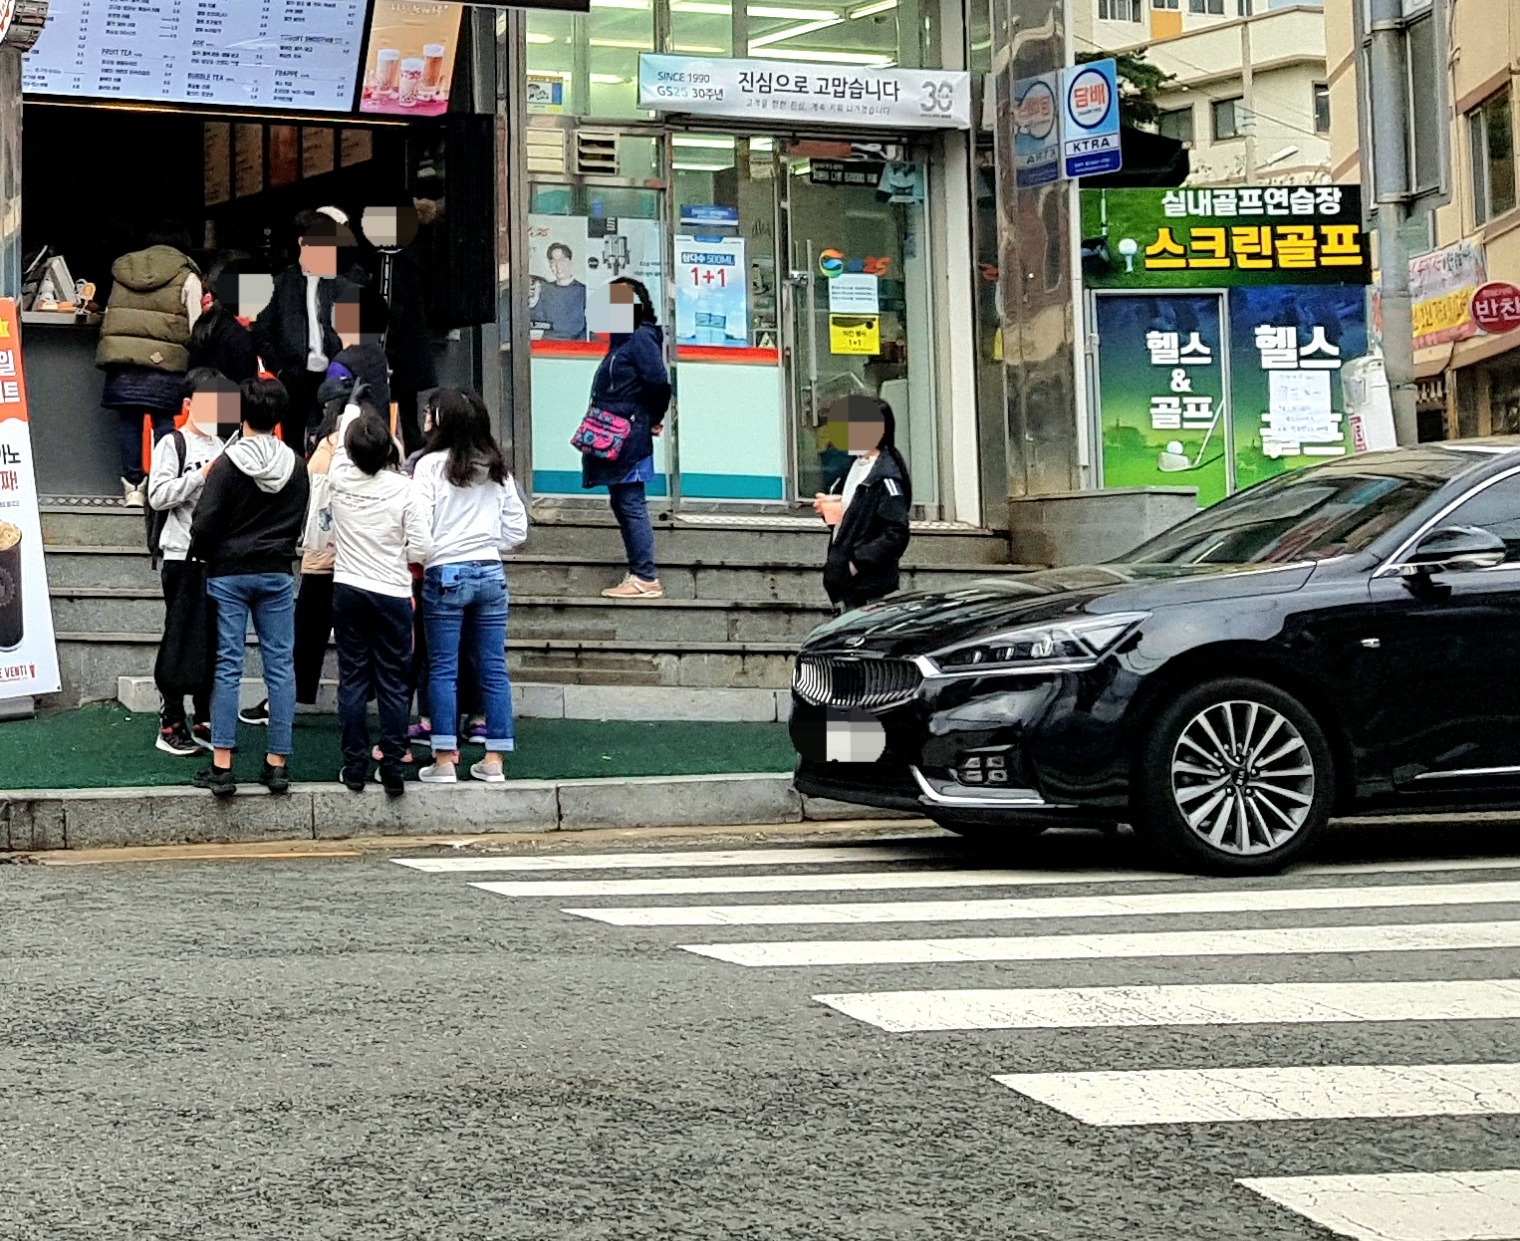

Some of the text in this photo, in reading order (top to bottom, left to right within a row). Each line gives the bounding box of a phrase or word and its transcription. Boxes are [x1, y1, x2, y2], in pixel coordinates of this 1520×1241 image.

[658, 71, 710, 84] SINCE 1990
[738, 71, 810, 97] 진심으로
[813, 76, 900, 103] 고맙습니다
[691, 88, 724, 102] 30주년
[1074, 82, 1105, 108] 담배
[1073, 138, 1110, 152] KTRA
[1161, 187, 1342, 218] 실내골프연습장
[1144, 224, 1363, 269] 스크린골프
[690, 266, 726, 288] 1+1
[1146, 330, 1212, 366] 헬스
[1254, 325, 1341, 369] 헬스
[1170, 369, 1192, 392] &
[1149, 396, 1214, 429] 골프
[4, 666, 27, 678] VENTI
